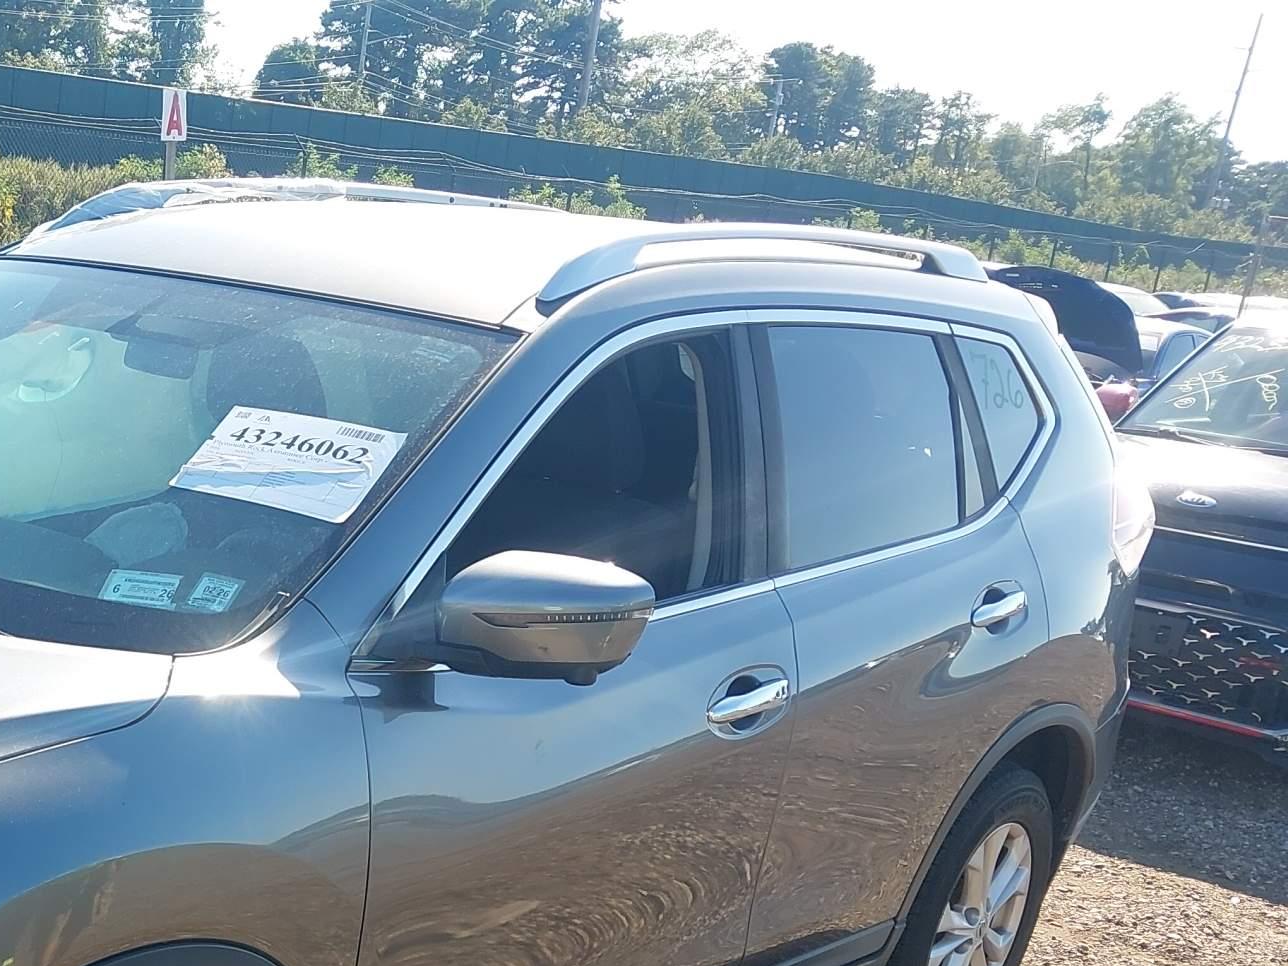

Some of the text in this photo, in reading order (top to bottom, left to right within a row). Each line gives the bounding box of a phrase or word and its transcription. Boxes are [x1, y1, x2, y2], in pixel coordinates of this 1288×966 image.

[166, 90, 183, 137] A
[230, 426, 369, 464] 43246062
[112, 584, 121, 594] 6
